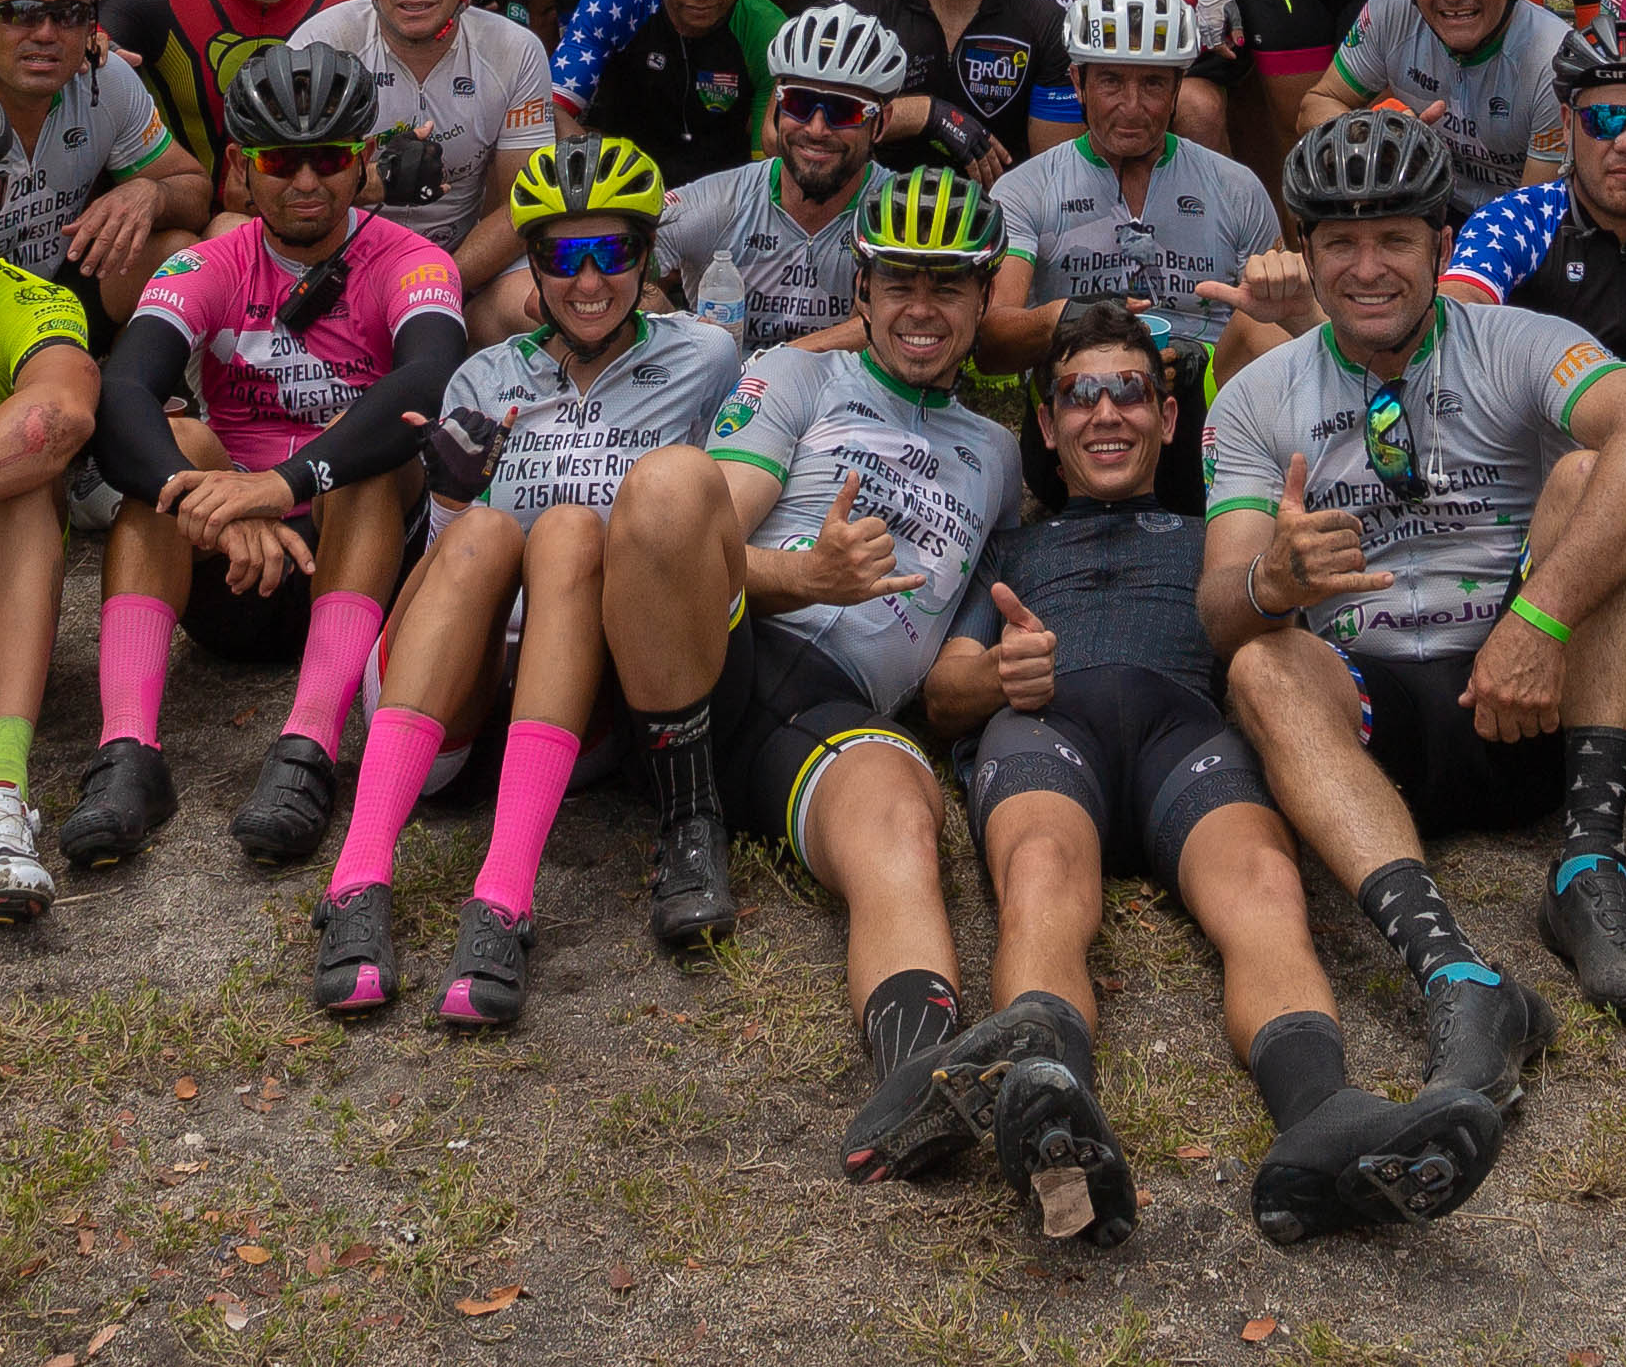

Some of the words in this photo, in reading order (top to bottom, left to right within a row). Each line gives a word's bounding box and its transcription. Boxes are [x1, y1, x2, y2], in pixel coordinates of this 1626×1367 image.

[965, 57, 1019, 82] BROU
[989, 84, 1012, 97] PRETO
[941, 116, 969, 140] TREK
[1443, 112, 1478, 139] 2018
[1060, 197, 1095, 214] #NQSF
[1060, 253, 1090, 273] 4TH
[1165, 250, 1215, 273] BEACH
[1069, 276, 1088, 295] TO
[1090, 274, 1122, 293] KEY
[750, 290, 824, 317] DEERFIELD
[747, 318, 782, 338] KEY
[271, 335, 307, 358] 2018
[323, 356, 375, 379] BEACH
[229, 383, 246, 401] TO
[247, 386, 280, 405] KEY
[281, 387, 328, 410] WEST
[555, 400, 603, 424] 2018
[524, 430, 605, 452] DEERFIELD
[605, 427, 662, 449] BEACH
[498, 459, 516, 483] TO
[516, 457, 552, 480] KEY
[556, 452, 603, 477] WEST
[898, 443, 940, 480] 2018
[514, 484, 550, 510] 215
[552, 481, 615, 507] MILES
[901, 490, 943, 529] WEST
[944, 516, 974, 555] RIDE
[943, 492, 985, 537] BEACH
[887, 510, 948, 558] MILES
